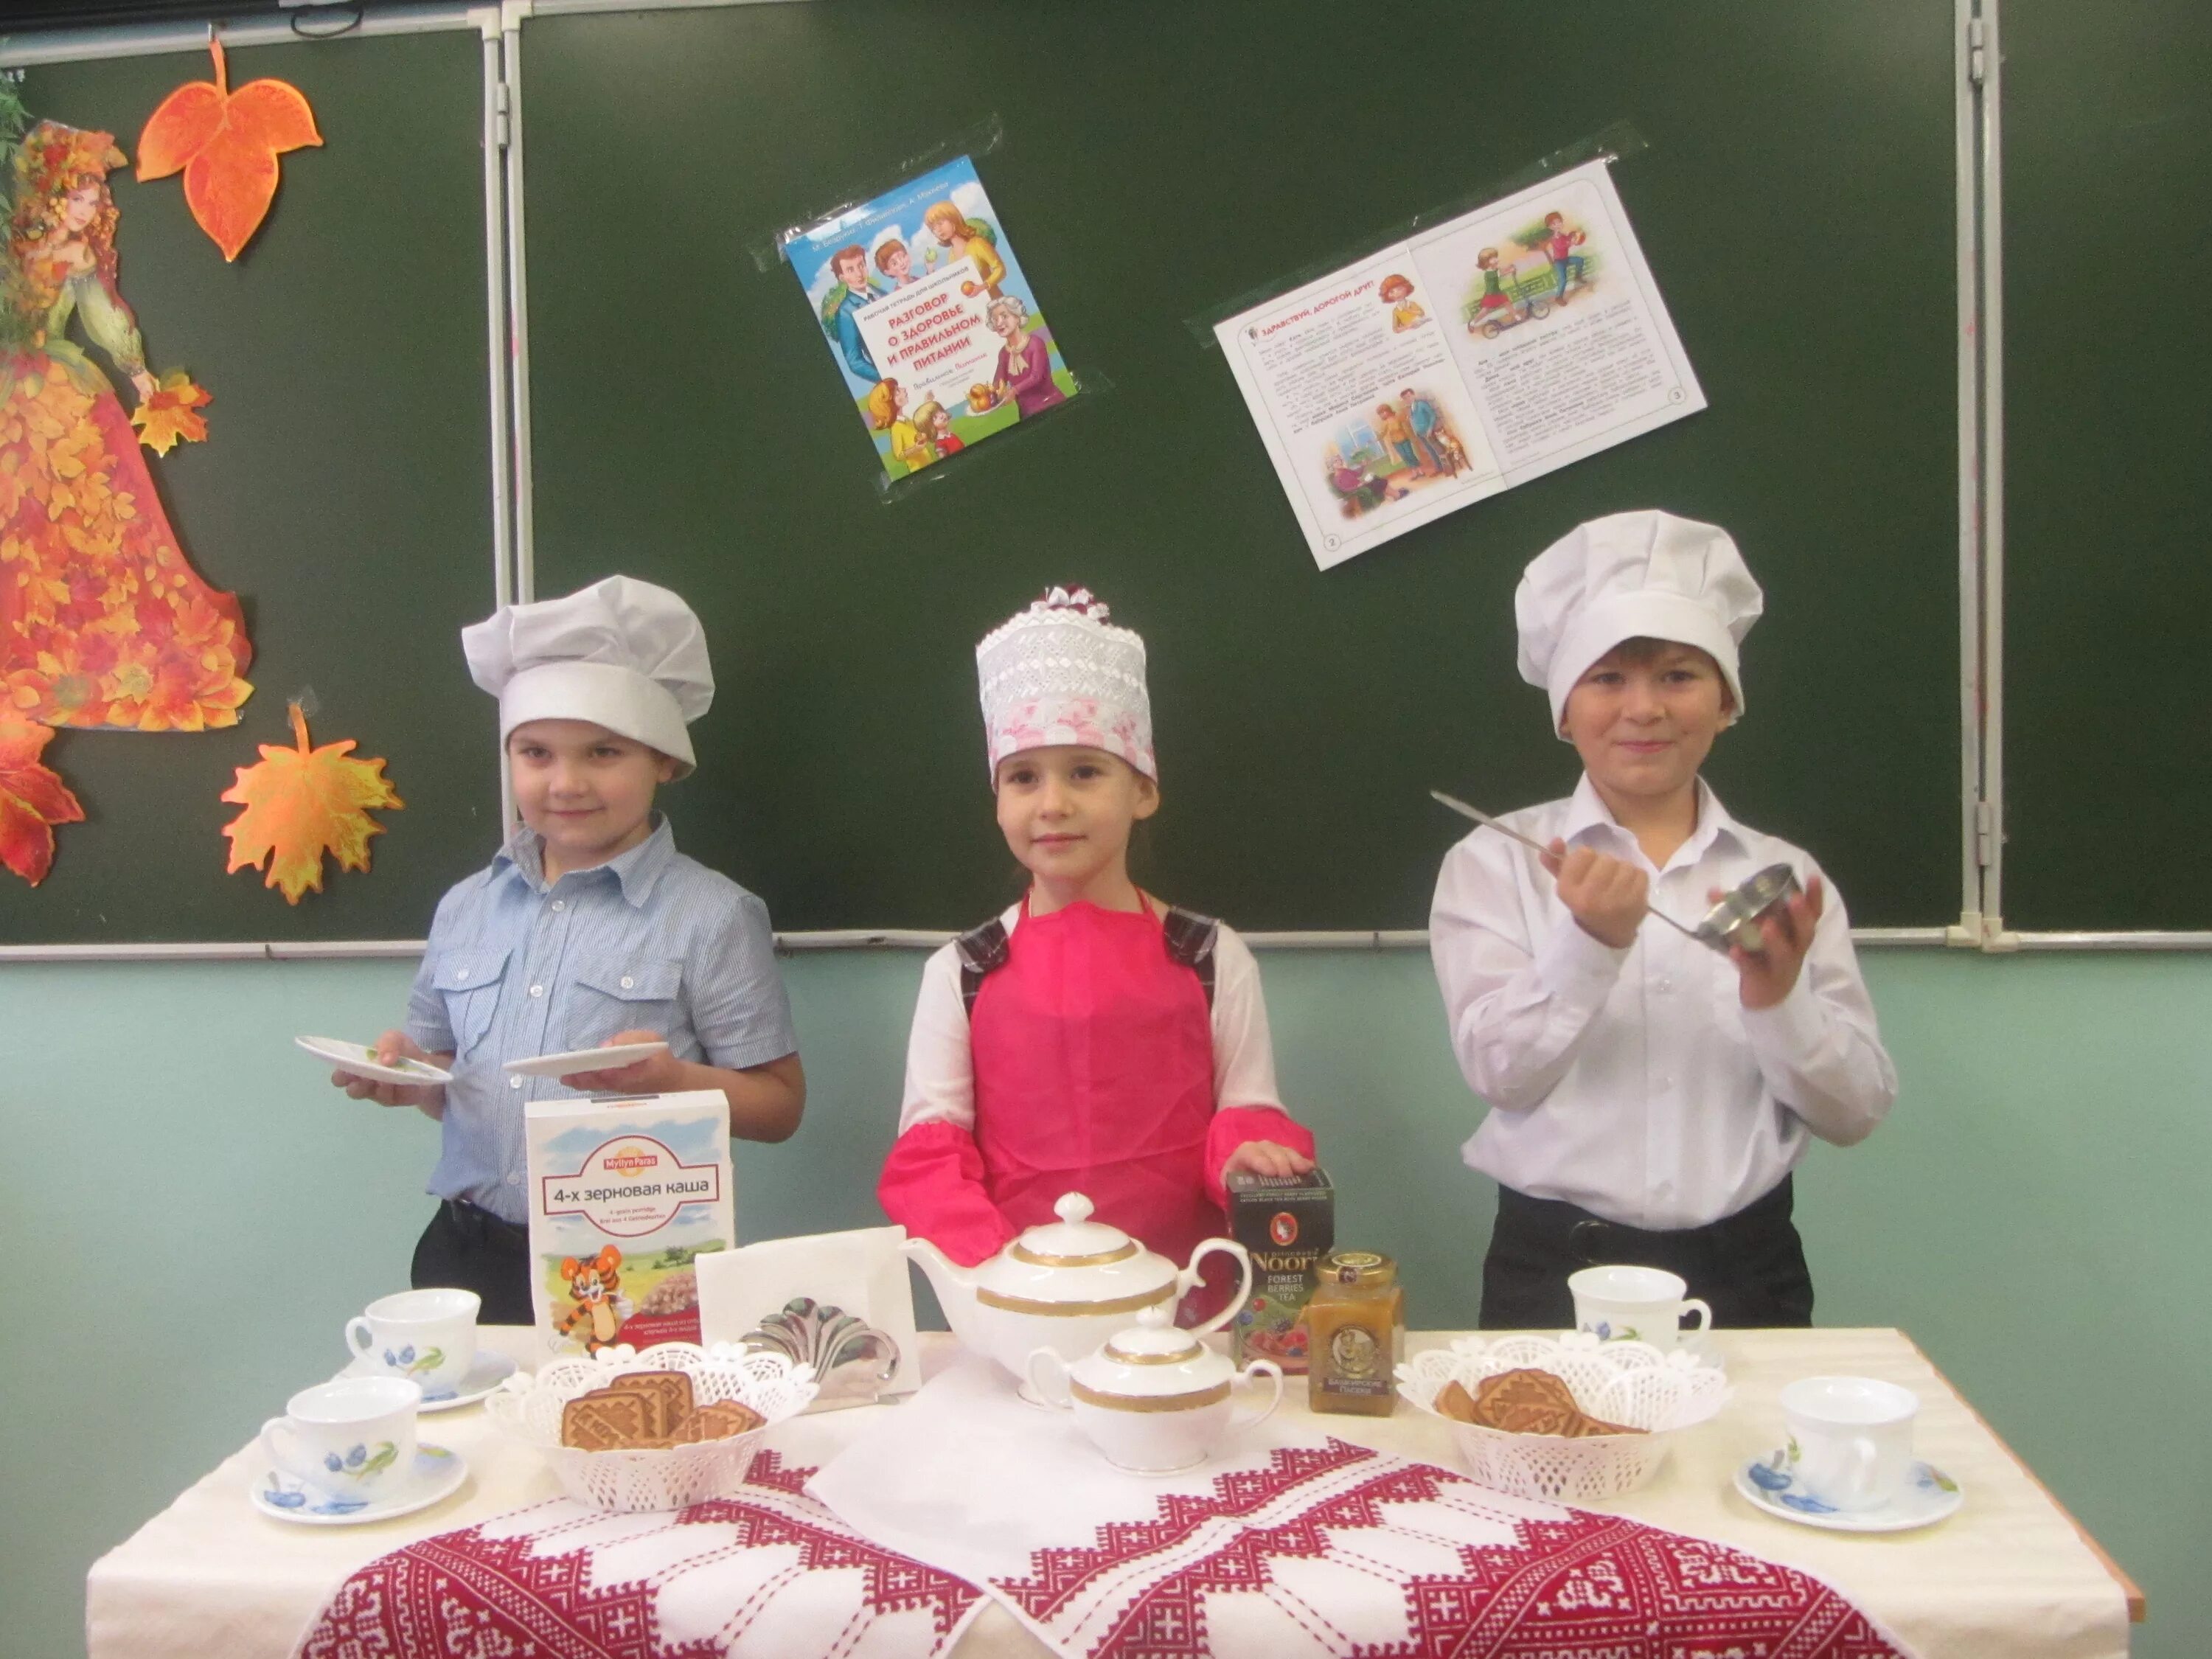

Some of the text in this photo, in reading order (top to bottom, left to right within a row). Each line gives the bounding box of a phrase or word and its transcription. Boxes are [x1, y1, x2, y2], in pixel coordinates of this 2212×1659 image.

[863, 267, 968, 320] РАБОЧАЯ ТЕТРАДЬ ДЛЯ ШКОЛЬНИКОВ
[888, 293, 948, 328] РАЗГОВОР
[1261, 308, 1312, 335] ЗДРАВСТВУЙ,
[1312, 291, 1351, 313] ДОРОГОЙ
[1352, 281, 1374, 295] ДРУГ!
[886, 305, 963, 347] О ЗДОРОВЬЕ
[886, 314, 981, 366] И ПРАВИЛЬНОМ
[913, 337, 970, 369] ПИТАНИИ
[1673, 390, 1681, 400] 3
[1327, 537, 1335, 546] 2
[606, 1155, 656, 1169] Myllyn Paras
[554, 1180, 709, 1204] 4-х зерновая каша
[1268, 1275, 1304, 1283] FOREST
[1268, 1284, 1304, 1292] BERRIES
[1280, 1293, 1296, 1301] TEA
